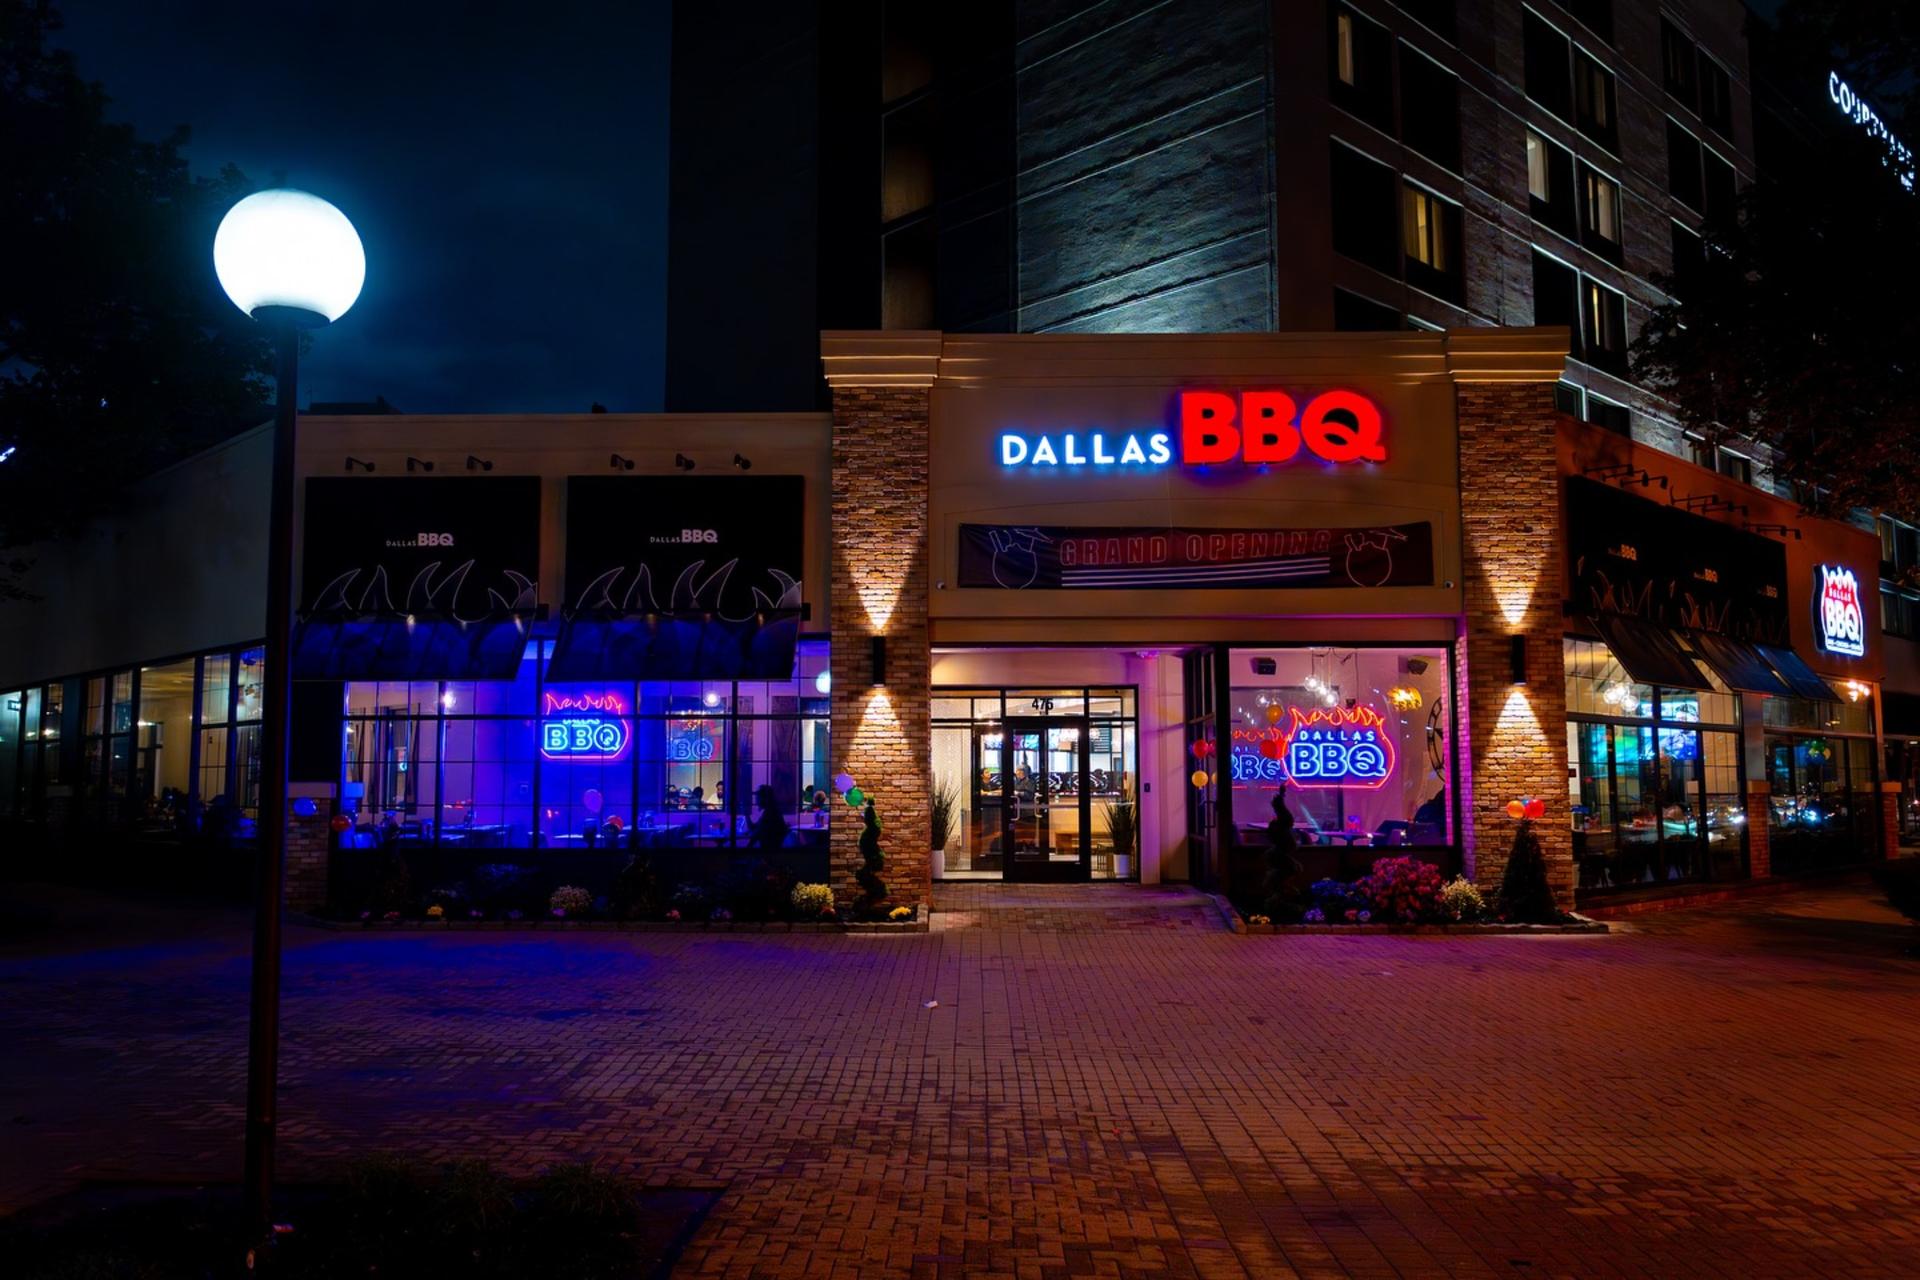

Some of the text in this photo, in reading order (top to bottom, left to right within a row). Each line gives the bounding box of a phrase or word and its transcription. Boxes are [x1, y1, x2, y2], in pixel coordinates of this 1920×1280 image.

[1002, 390, 1386, 465] DALLAS BBQ
[385, 532, 455, 548] DALLAS BBQ
[681, 529, 718, 543] BBQ
[1060, 530, 1332, 566] GRAND OPENING
[1825, 597, 1860, 641] BBQ
[544, 724, 621, 751] BBQ
[665, 738, 713, 760] BQ
[1300, 730, 1375, 742] DALLAS
[1292, 743, 1387, 777] BBQ
